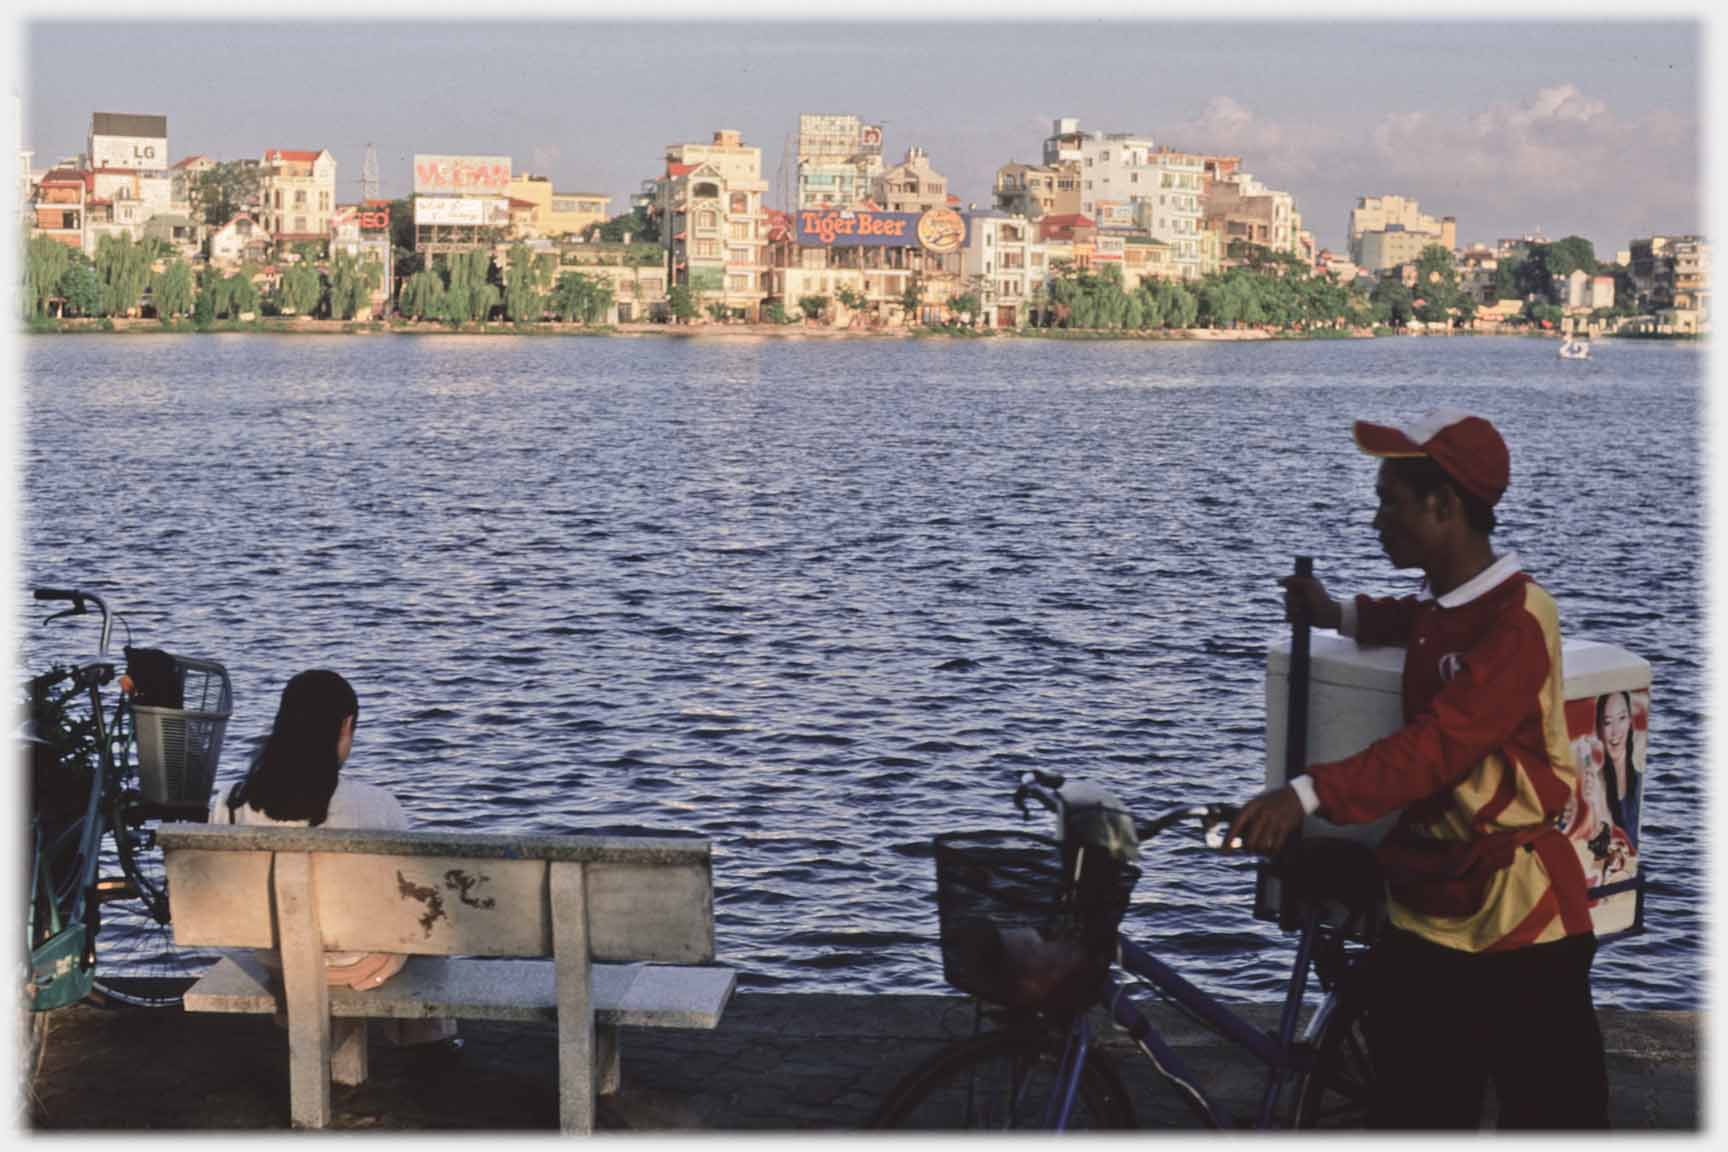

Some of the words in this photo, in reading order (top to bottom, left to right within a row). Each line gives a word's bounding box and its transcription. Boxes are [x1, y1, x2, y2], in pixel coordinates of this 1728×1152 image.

[133, 145, 155, 159] LG
[801, 210, 856, 243] Tiger
[857, 213, 907, 236] Beer
